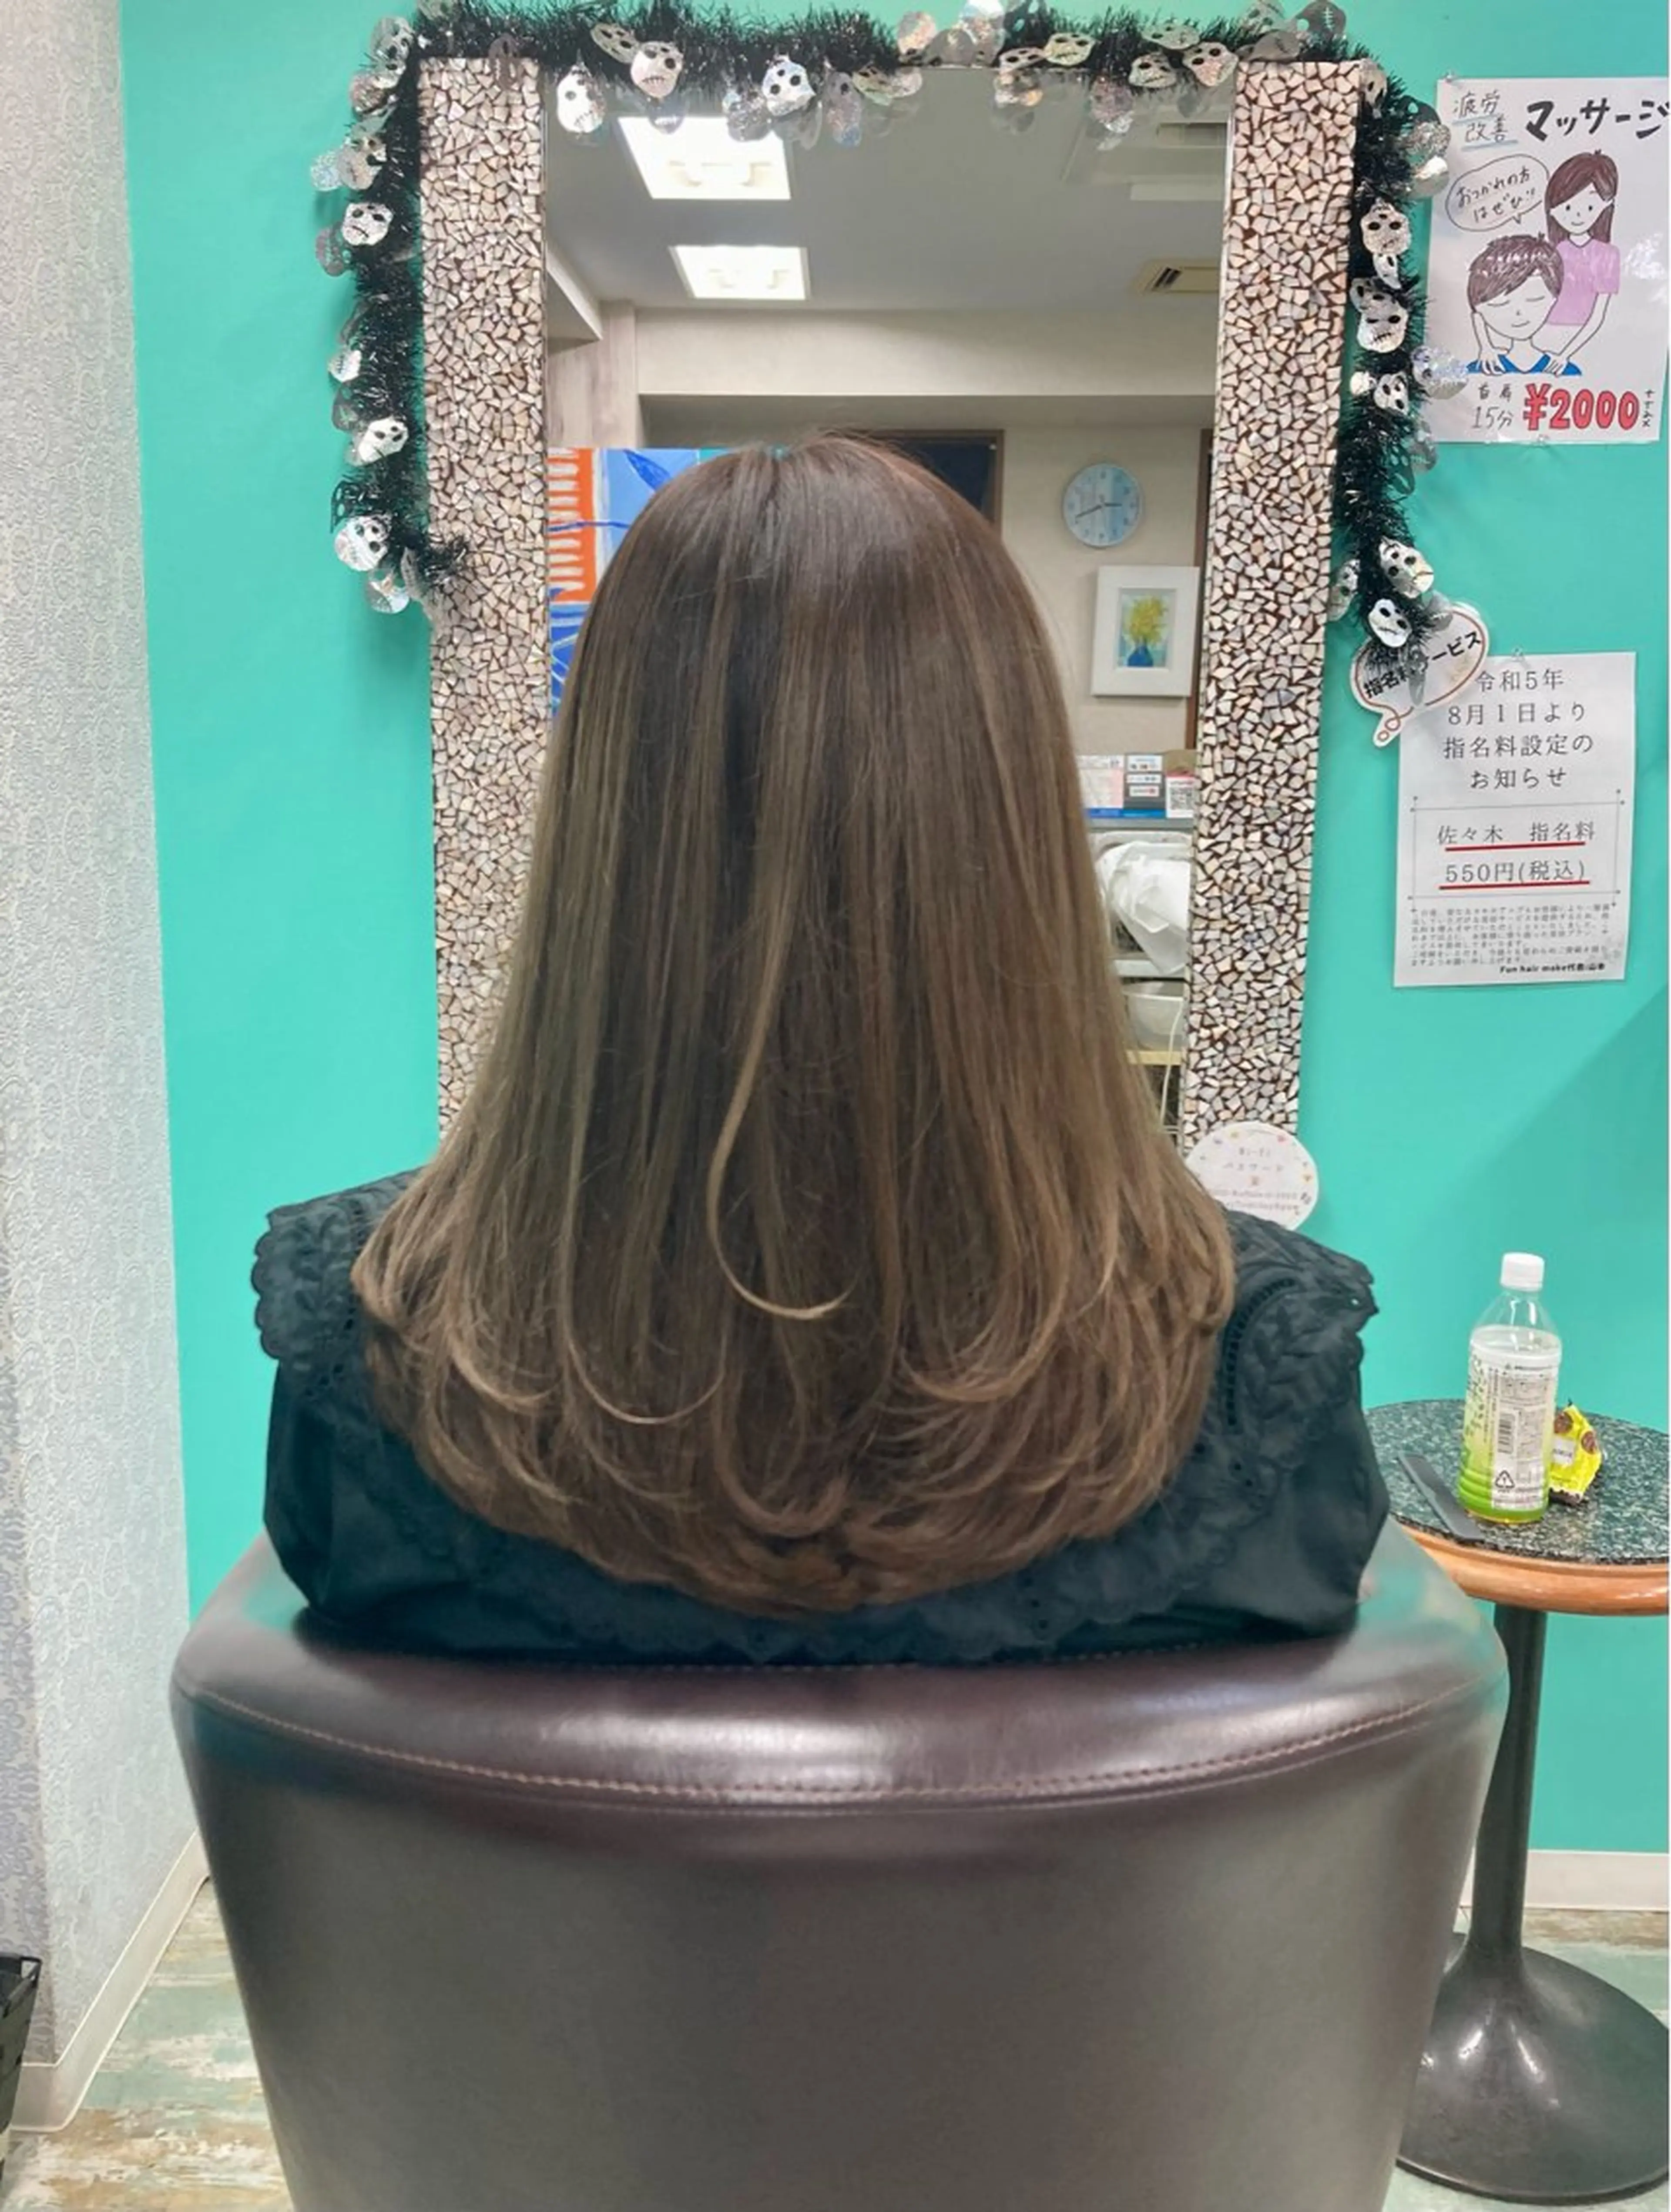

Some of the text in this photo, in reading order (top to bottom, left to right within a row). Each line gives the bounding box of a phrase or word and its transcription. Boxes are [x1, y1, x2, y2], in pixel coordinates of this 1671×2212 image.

[1453, 89, 1500, 119] 疲労
[1465, 114, 1508, 143] 改善
[1471, 406, 1514, 431] 15分
[1523, 382, 1640, 431] ¥2000
[1475, 668, 1564, 693] 令和5年
[1443, 734, 1594, 759] 指名料設定の
[1470, 767, 1567, 790] お知らせ
[1437, 821, 1595, 845] 佐々木 指名料
